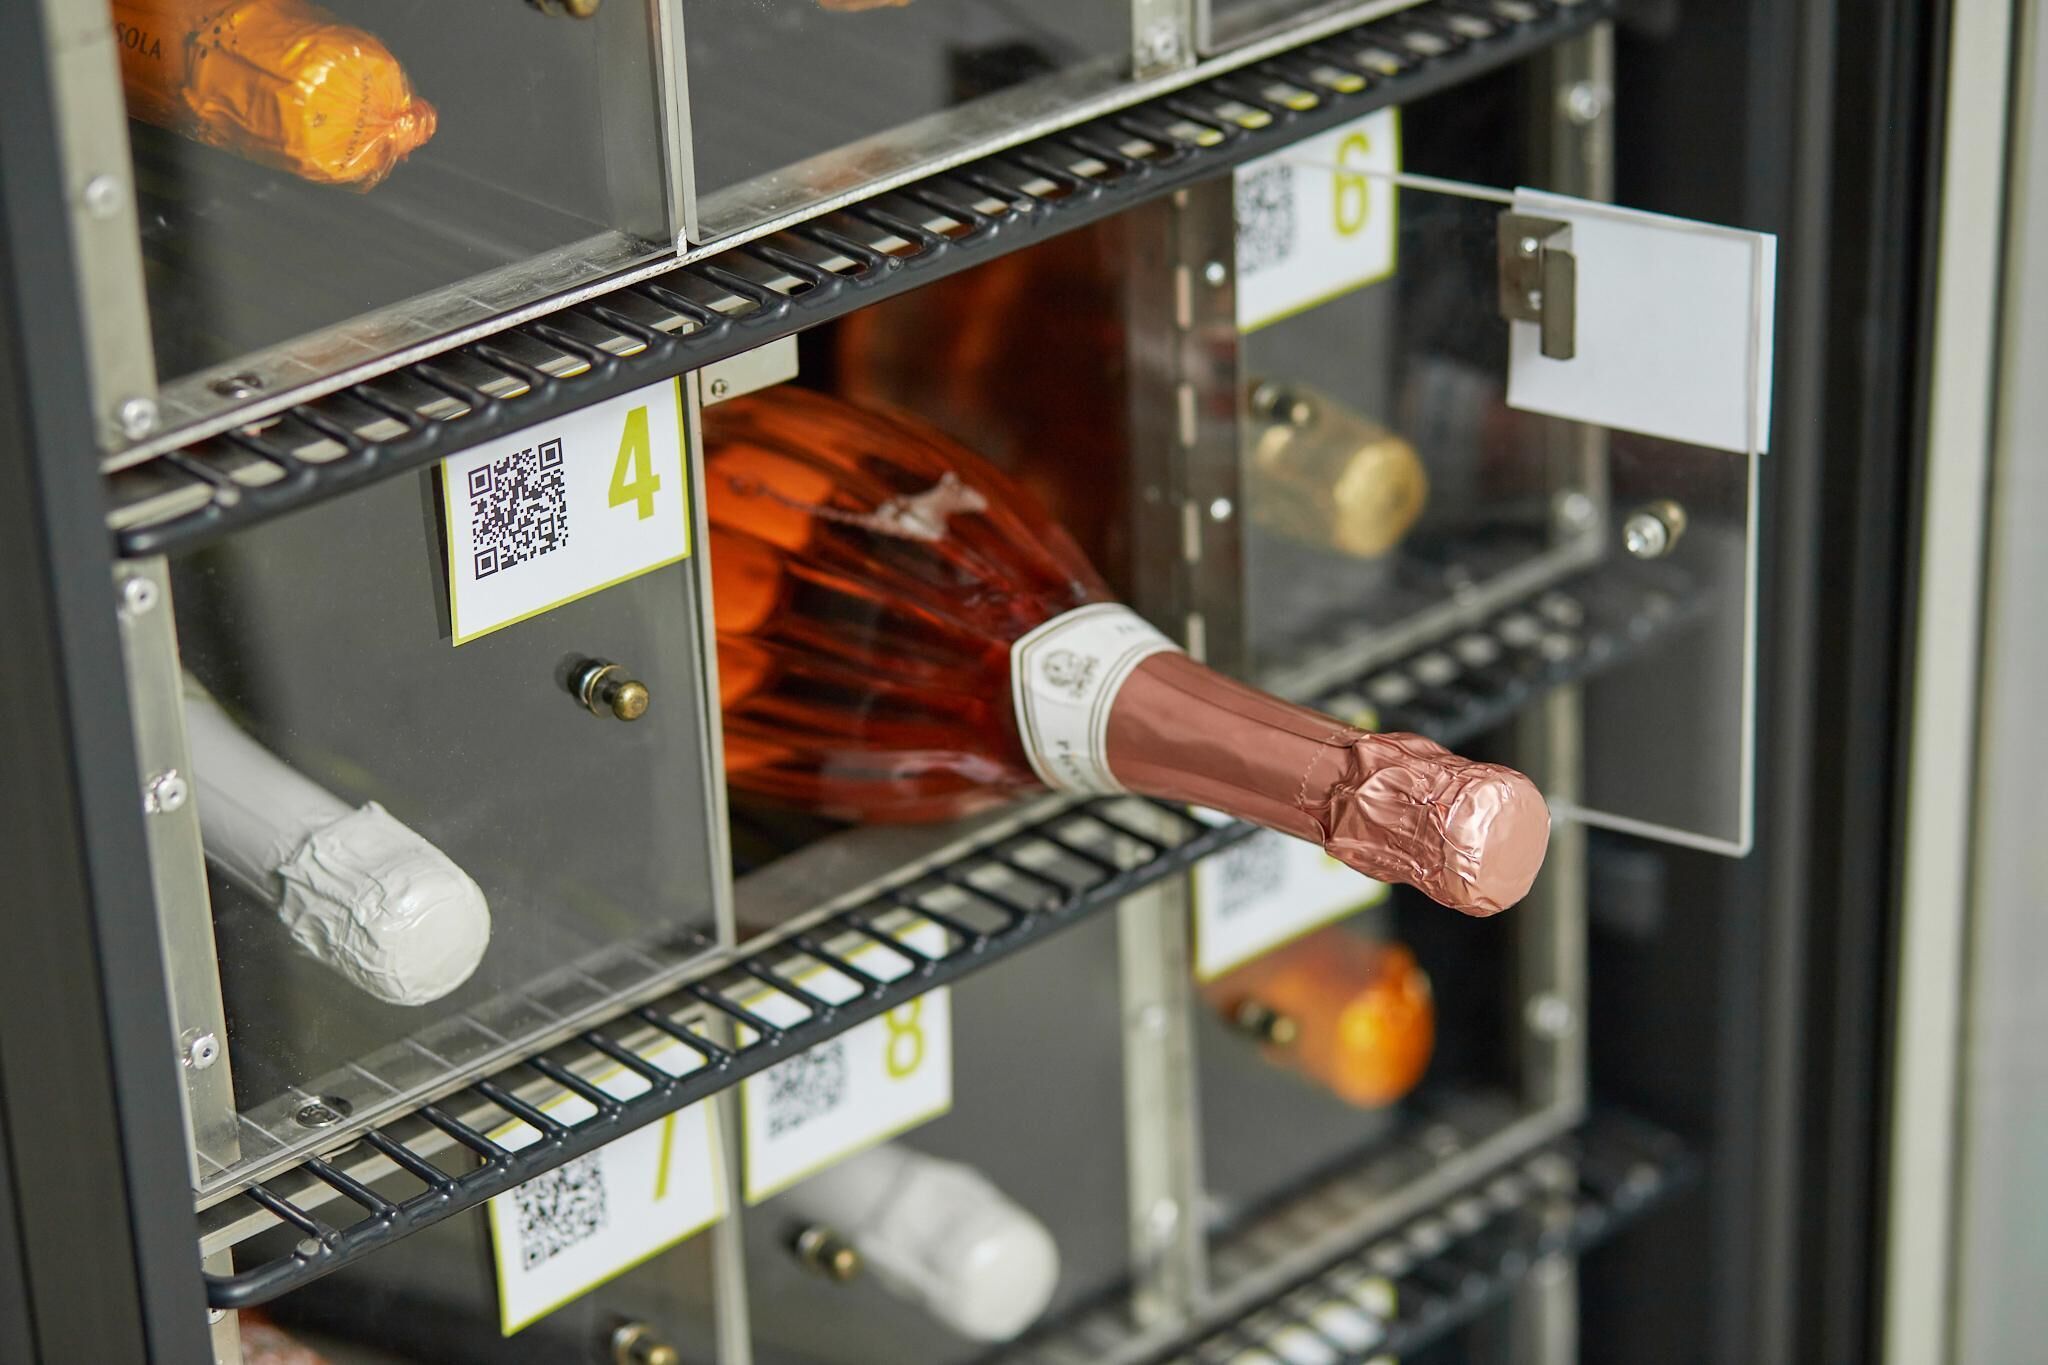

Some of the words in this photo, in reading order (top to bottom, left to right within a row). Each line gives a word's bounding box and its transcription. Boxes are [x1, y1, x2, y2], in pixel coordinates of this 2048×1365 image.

[1334, 132, 1370, 236] 6
[608, 405, 661, 521] 4
[885, 992, 923, 1079] 8
